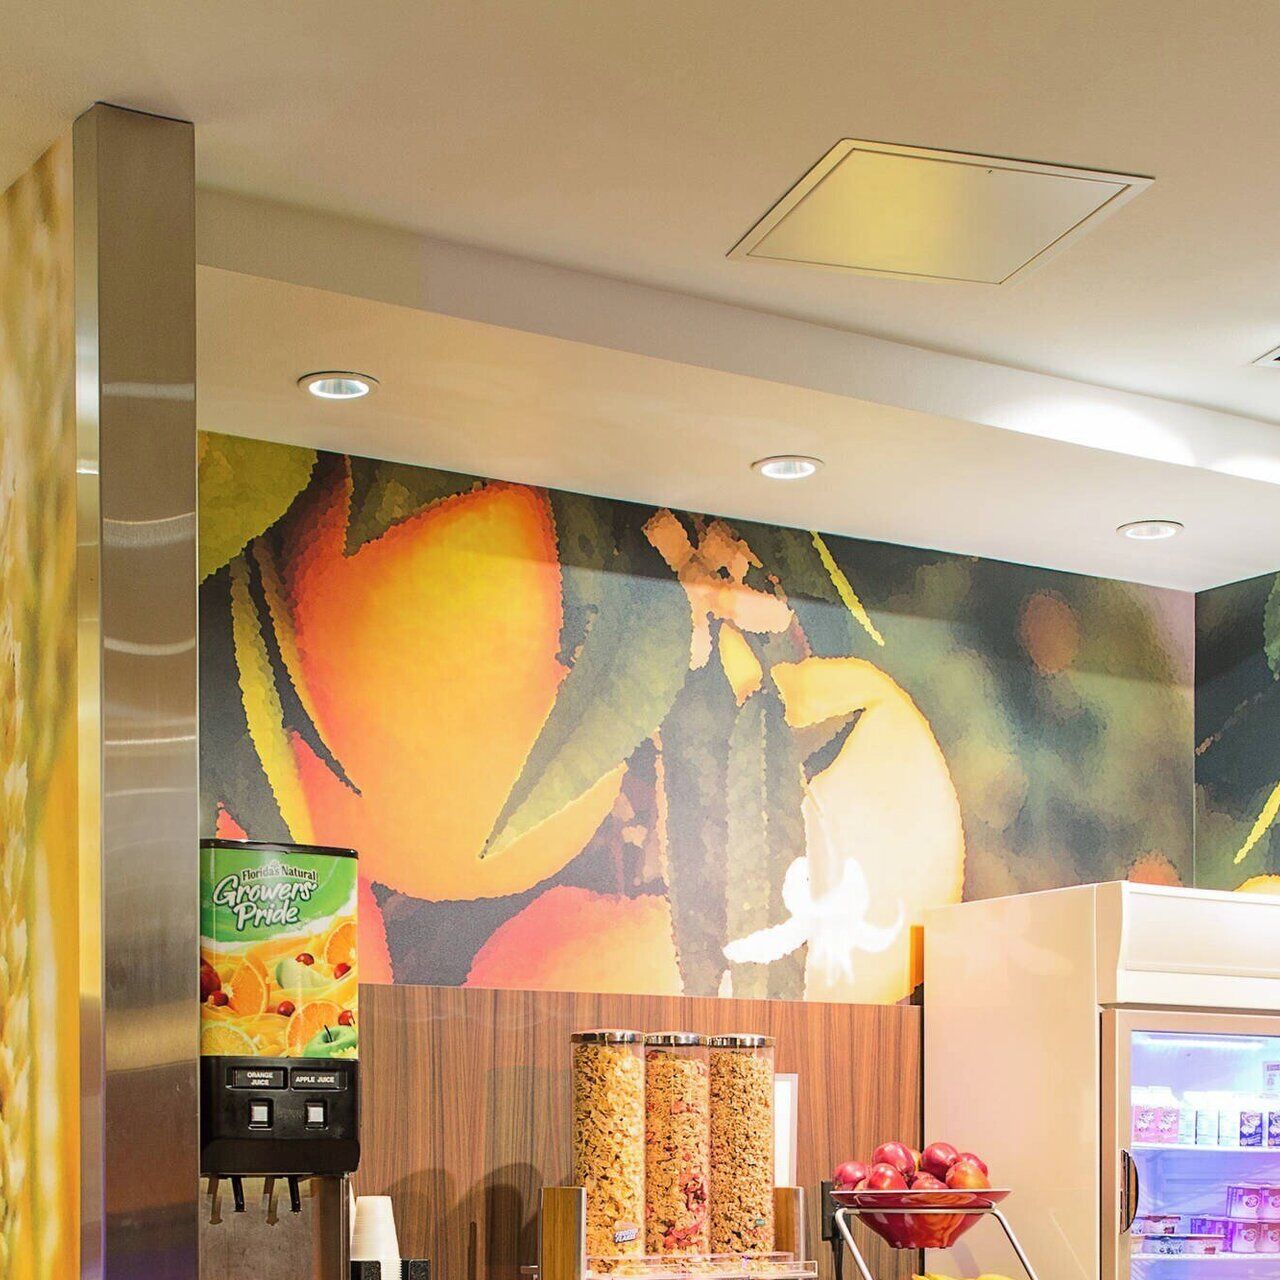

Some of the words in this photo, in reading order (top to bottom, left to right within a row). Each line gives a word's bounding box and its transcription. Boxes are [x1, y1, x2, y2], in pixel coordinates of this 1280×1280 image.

[281, 865, 317, 881] Natural
[232, 899, 300, 931] Pride
[246, 1071, 274, 1079] ORANGE
[250, 1079, 270, 1087] JUICE
